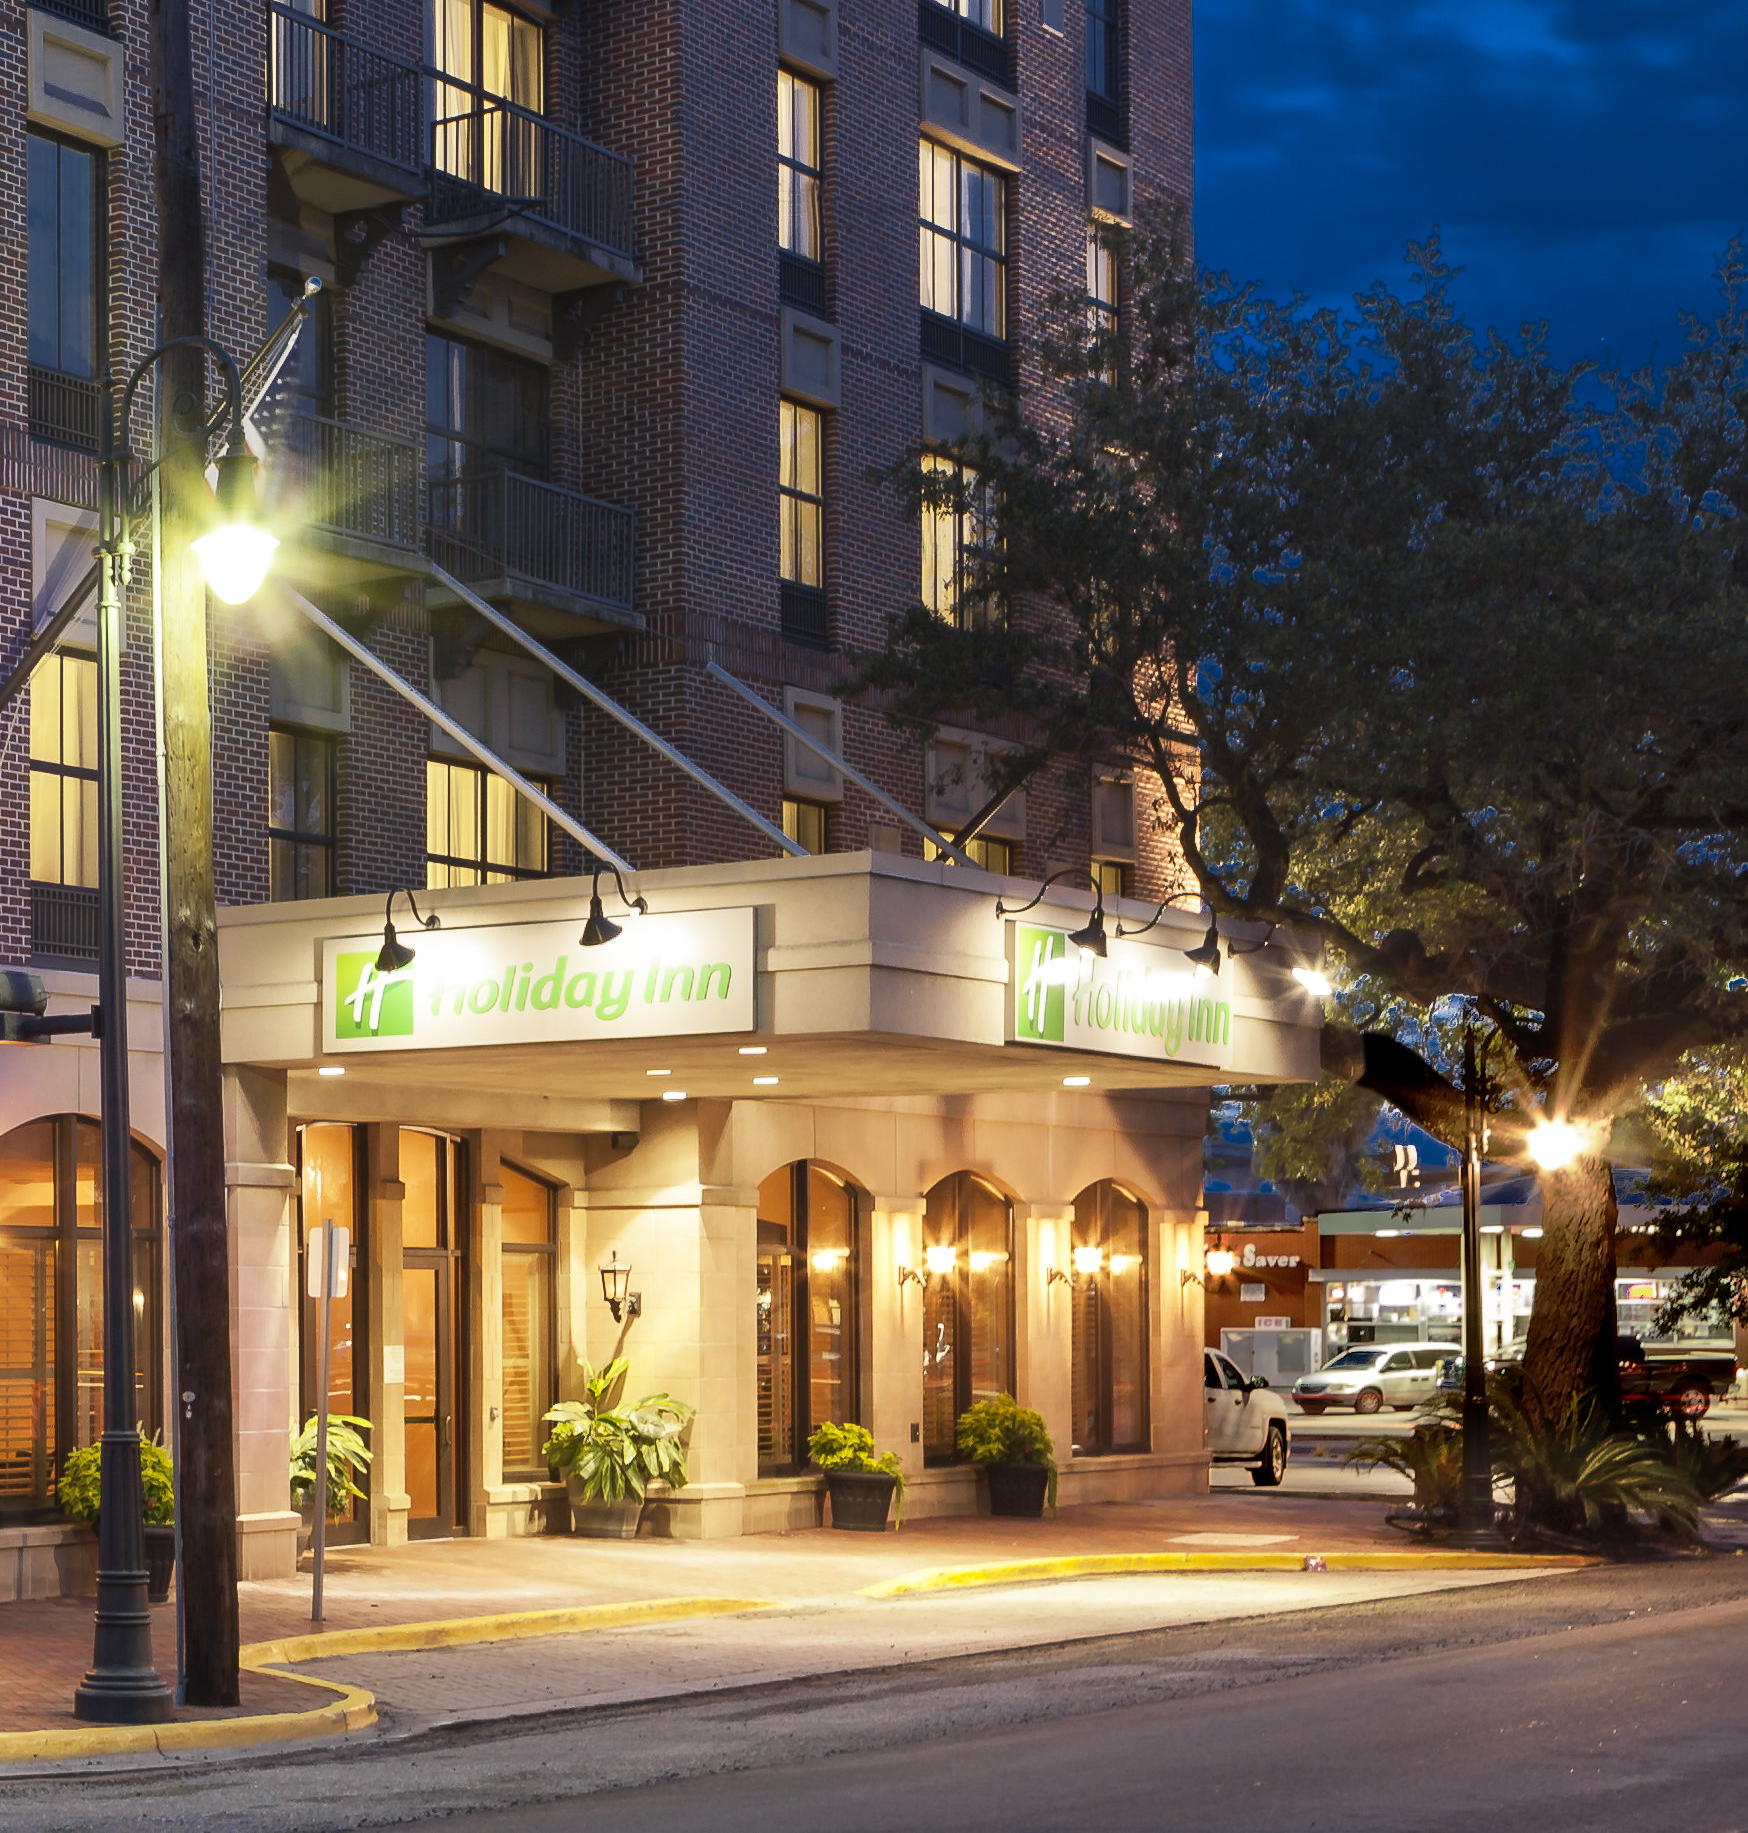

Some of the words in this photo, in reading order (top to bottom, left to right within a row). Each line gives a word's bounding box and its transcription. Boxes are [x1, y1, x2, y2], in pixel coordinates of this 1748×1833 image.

[427, 954, 634, 1021] Holiday
[643, 958, 732, 1004] Inn
[1243, 1243, 1301, 1267] Saver
[1258, 1317, 1283, 1327] ICE
